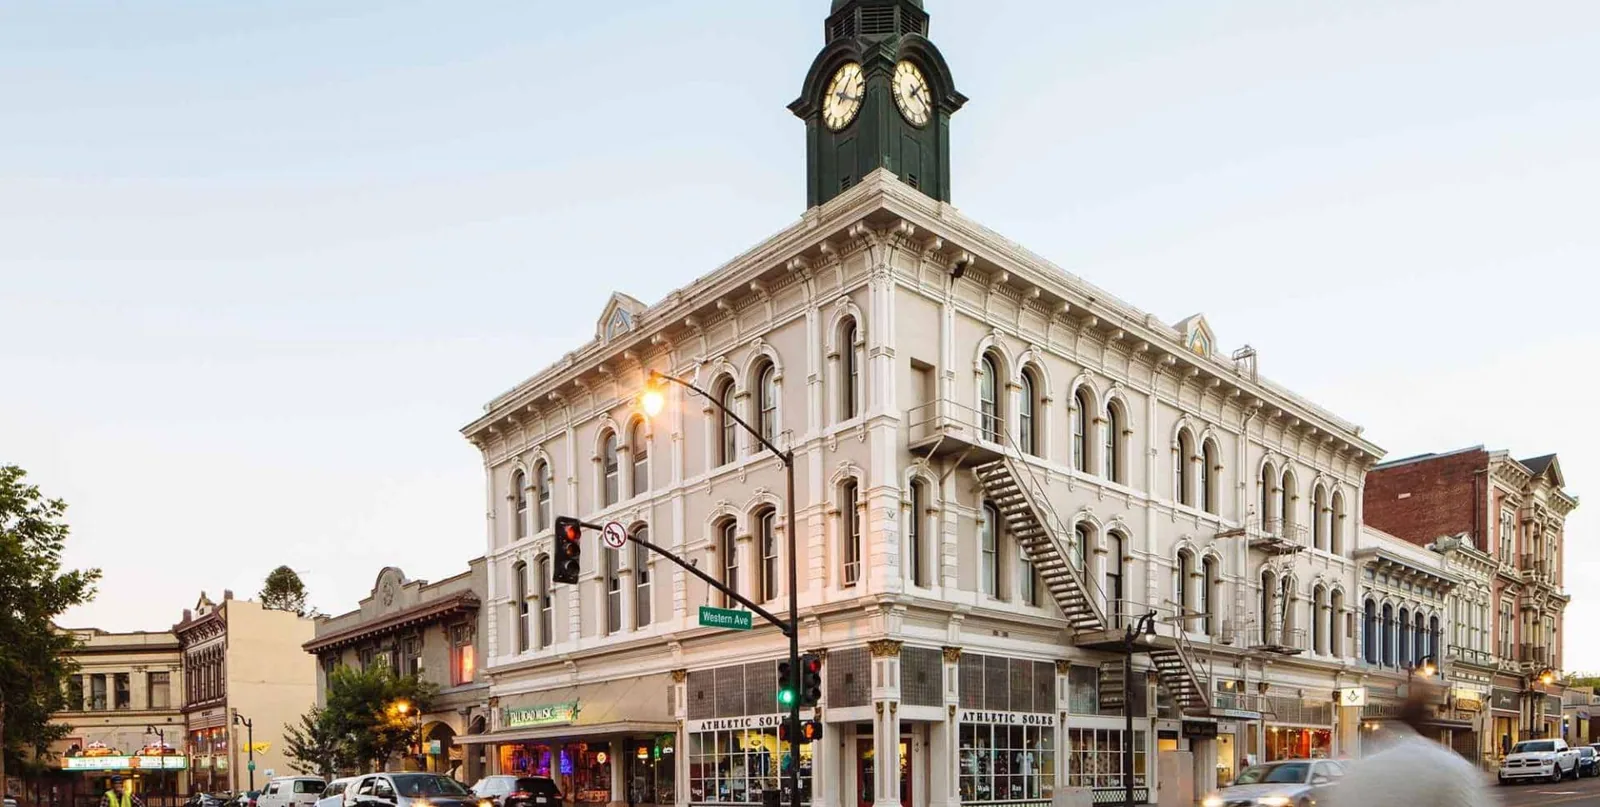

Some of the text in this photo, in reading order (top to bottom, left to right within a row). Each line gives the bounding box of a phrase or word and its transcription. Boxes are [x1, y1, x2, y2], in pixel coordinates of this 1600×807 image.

[703, 611, 748, 626] Western Ave
[701, 718, 752, 730] ATHLETIC
[963, 712, 1053, 725] ATHLETIC SOLES
